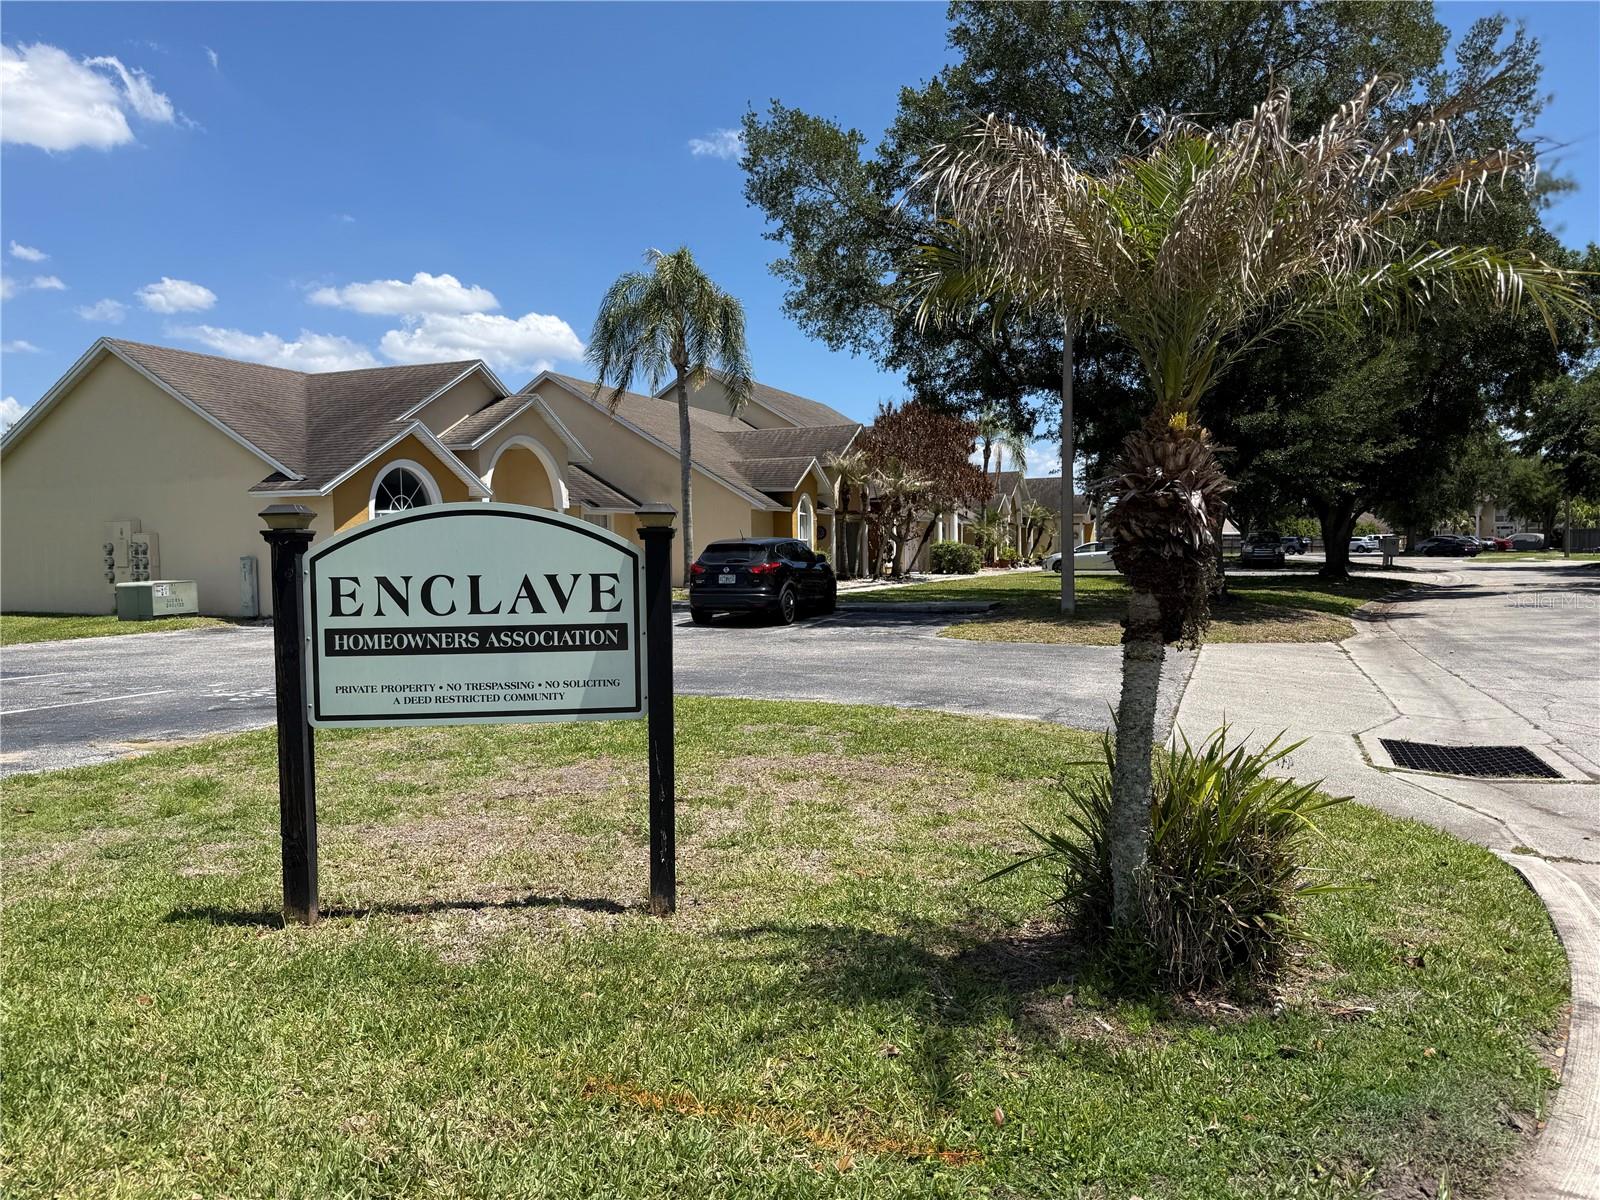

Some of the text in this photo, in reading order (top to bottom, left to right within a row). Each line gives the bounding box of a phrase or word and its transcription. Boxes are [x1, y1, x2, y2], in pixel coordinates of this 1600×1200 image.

[328, 573, 623, 617] ENCLAVE
[334, 629, 618, 650] HOMEOWNERS ASSOCIATION
[335, 679, 621, 694] PRIVATE PROPERTY NO TRESPASSING NO SOLICITING
[393, 692, 565, 704] A DEED RESTRICTED COMMUNITY
